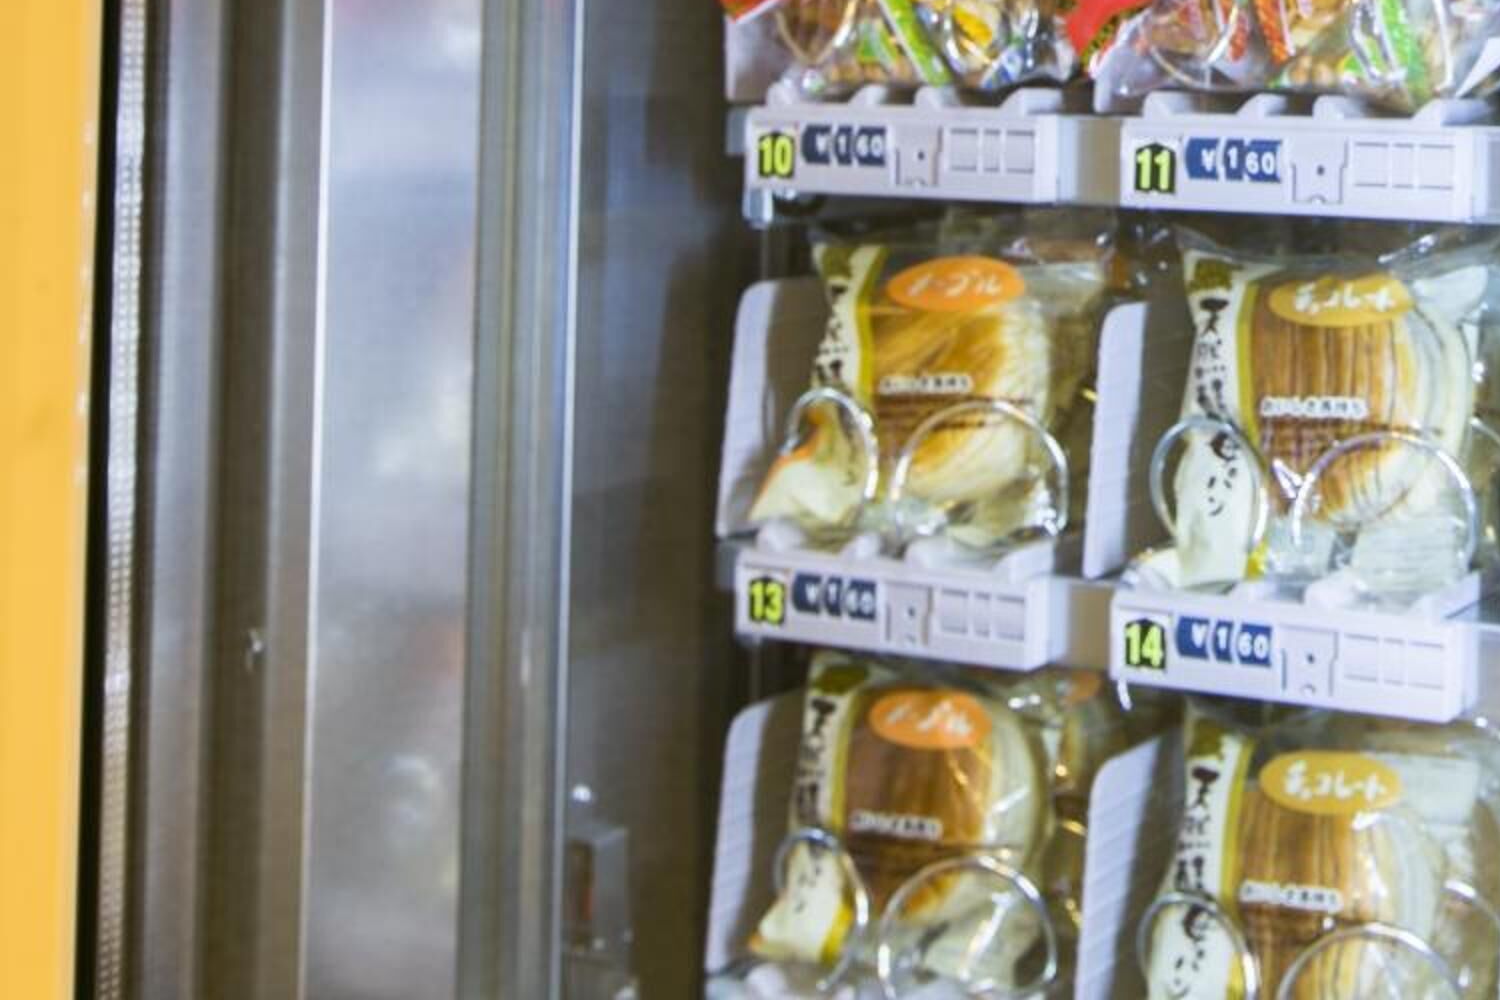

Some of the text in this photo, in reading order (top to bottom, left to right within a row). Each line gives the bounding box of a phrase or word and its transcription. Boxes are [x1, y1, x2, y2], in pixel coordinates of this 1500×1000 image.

[760, 135, 793, 176] 10
[1135, 148, 1170, 190] 11
[750, 580, 784, 624] 13
[1125, 625, 1164, 667] 14
